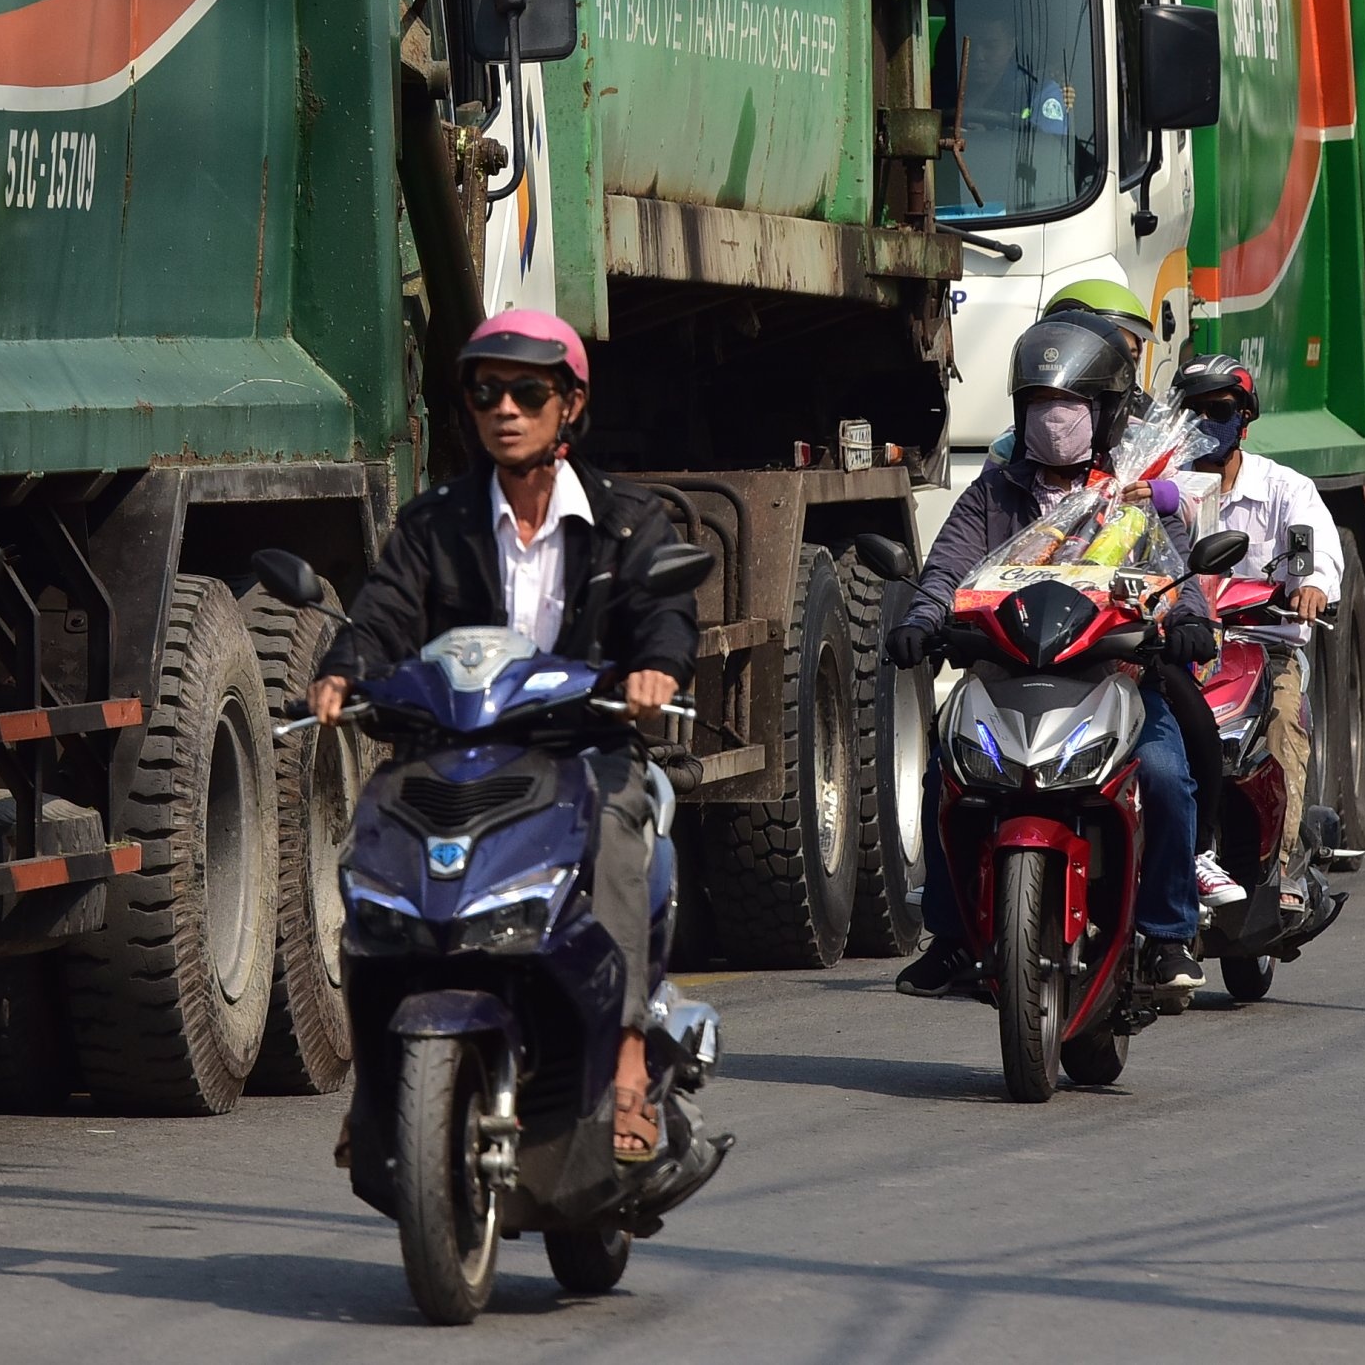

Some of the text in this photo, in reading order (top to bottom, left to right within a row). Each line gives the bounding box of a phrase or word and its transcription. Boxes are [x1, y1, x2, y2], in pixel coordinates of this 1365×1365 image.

[771, 6, 810, 84] SẠCH
[810, 13, 837, 91] ĐẸP
[4, 128, 97, 212] 51C-15709
[999, 567, 1062, 582] Coffee
